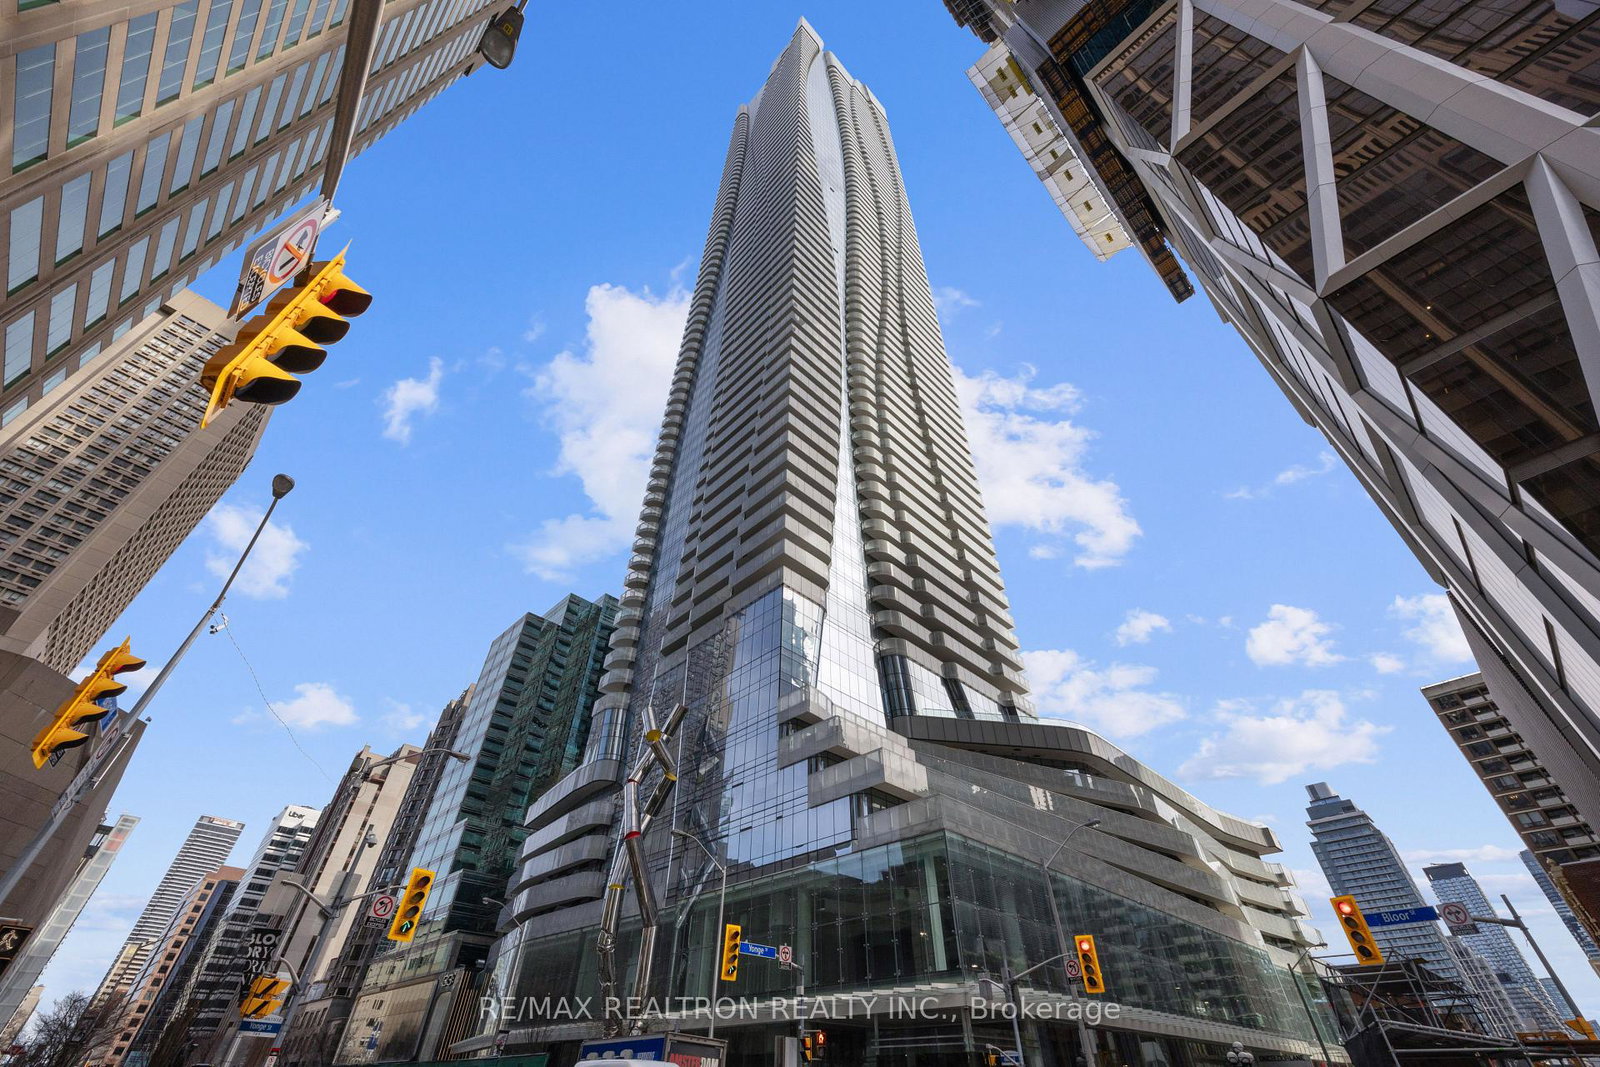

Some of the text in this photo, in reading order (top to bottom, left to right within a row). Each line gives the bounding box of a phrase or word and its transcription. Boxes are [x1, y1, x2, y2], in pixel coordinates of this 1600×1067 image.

[252, 248, 274, 302] BICYCLES
[288, 811, 306, 819] Uber
[1381, 912, 1410, 922] Bloor
[748, 944, 764, 955] Yonge
